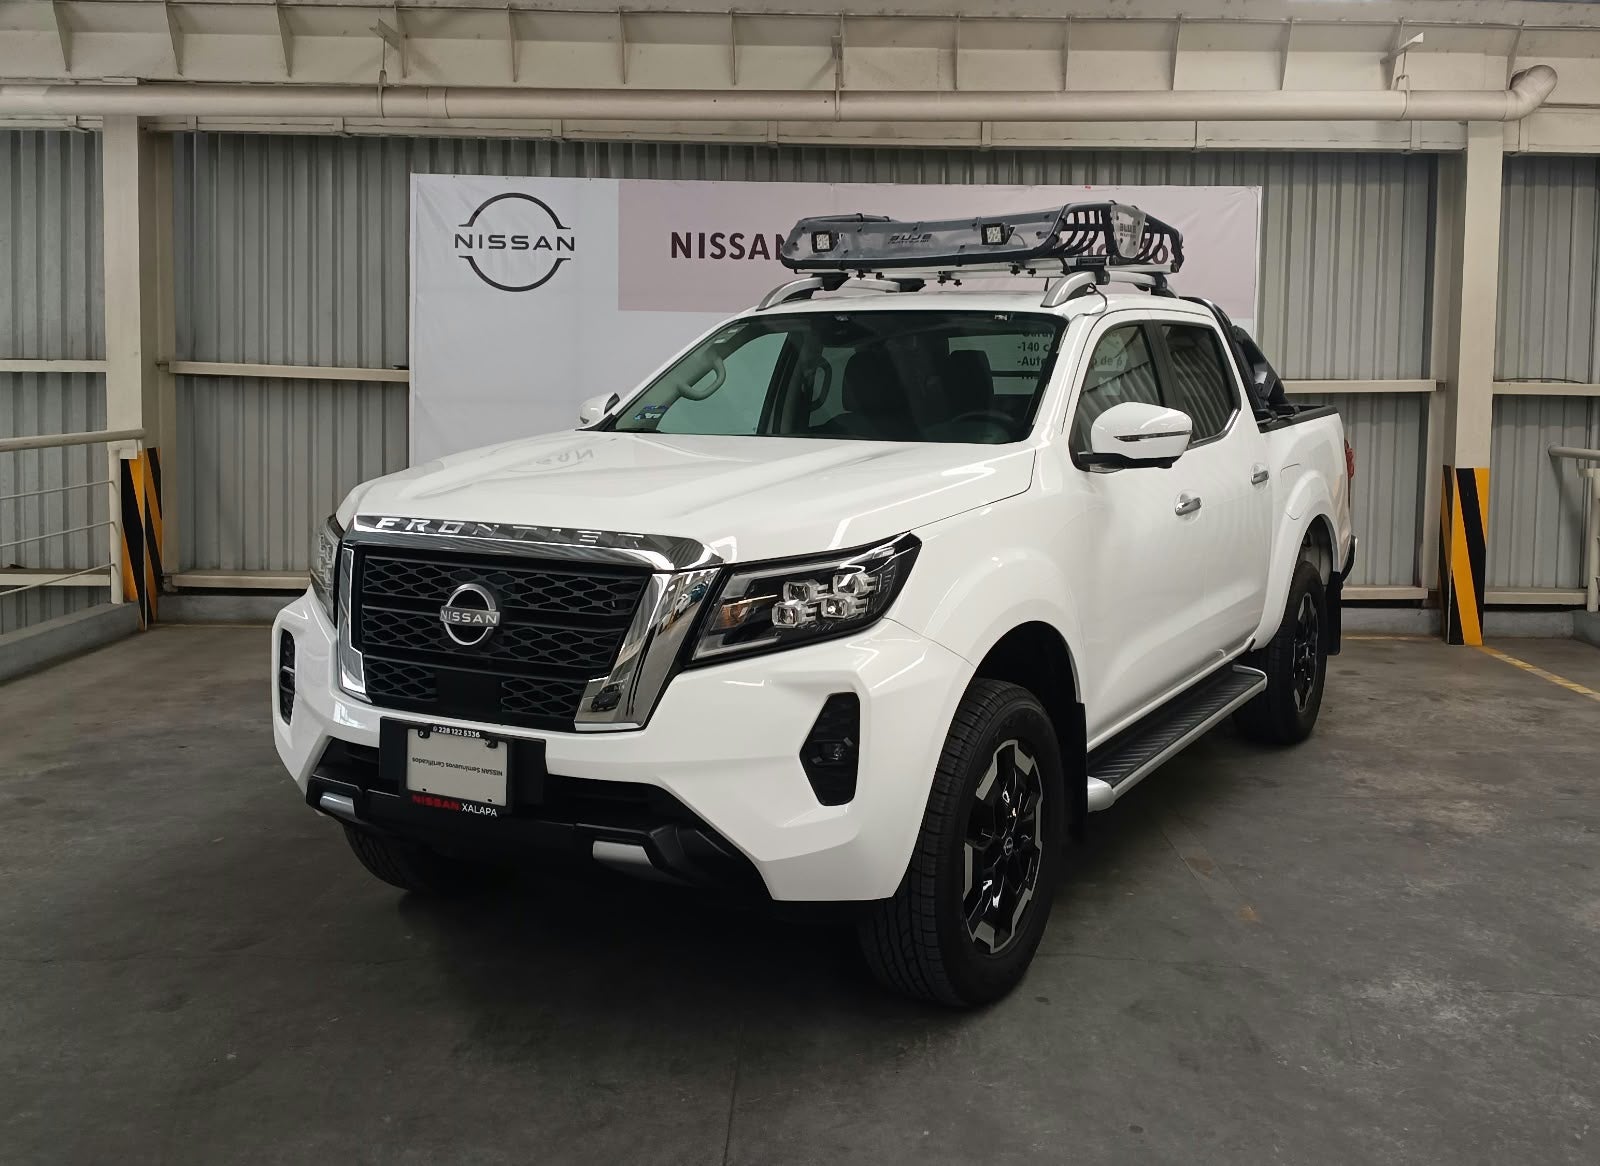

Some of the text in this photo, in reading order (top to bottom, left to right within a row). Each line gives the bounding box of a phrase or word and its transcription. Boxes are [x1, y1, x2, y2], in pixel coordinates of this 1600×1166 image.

[454, 233, 576, 251] NISSAN
[440, 609, 497, 624] NISSAN
[412, 757, 502, 776] NISSAN Seminuevos Certificados
[412, 794, 498, 817] NISSAN XALAPA
